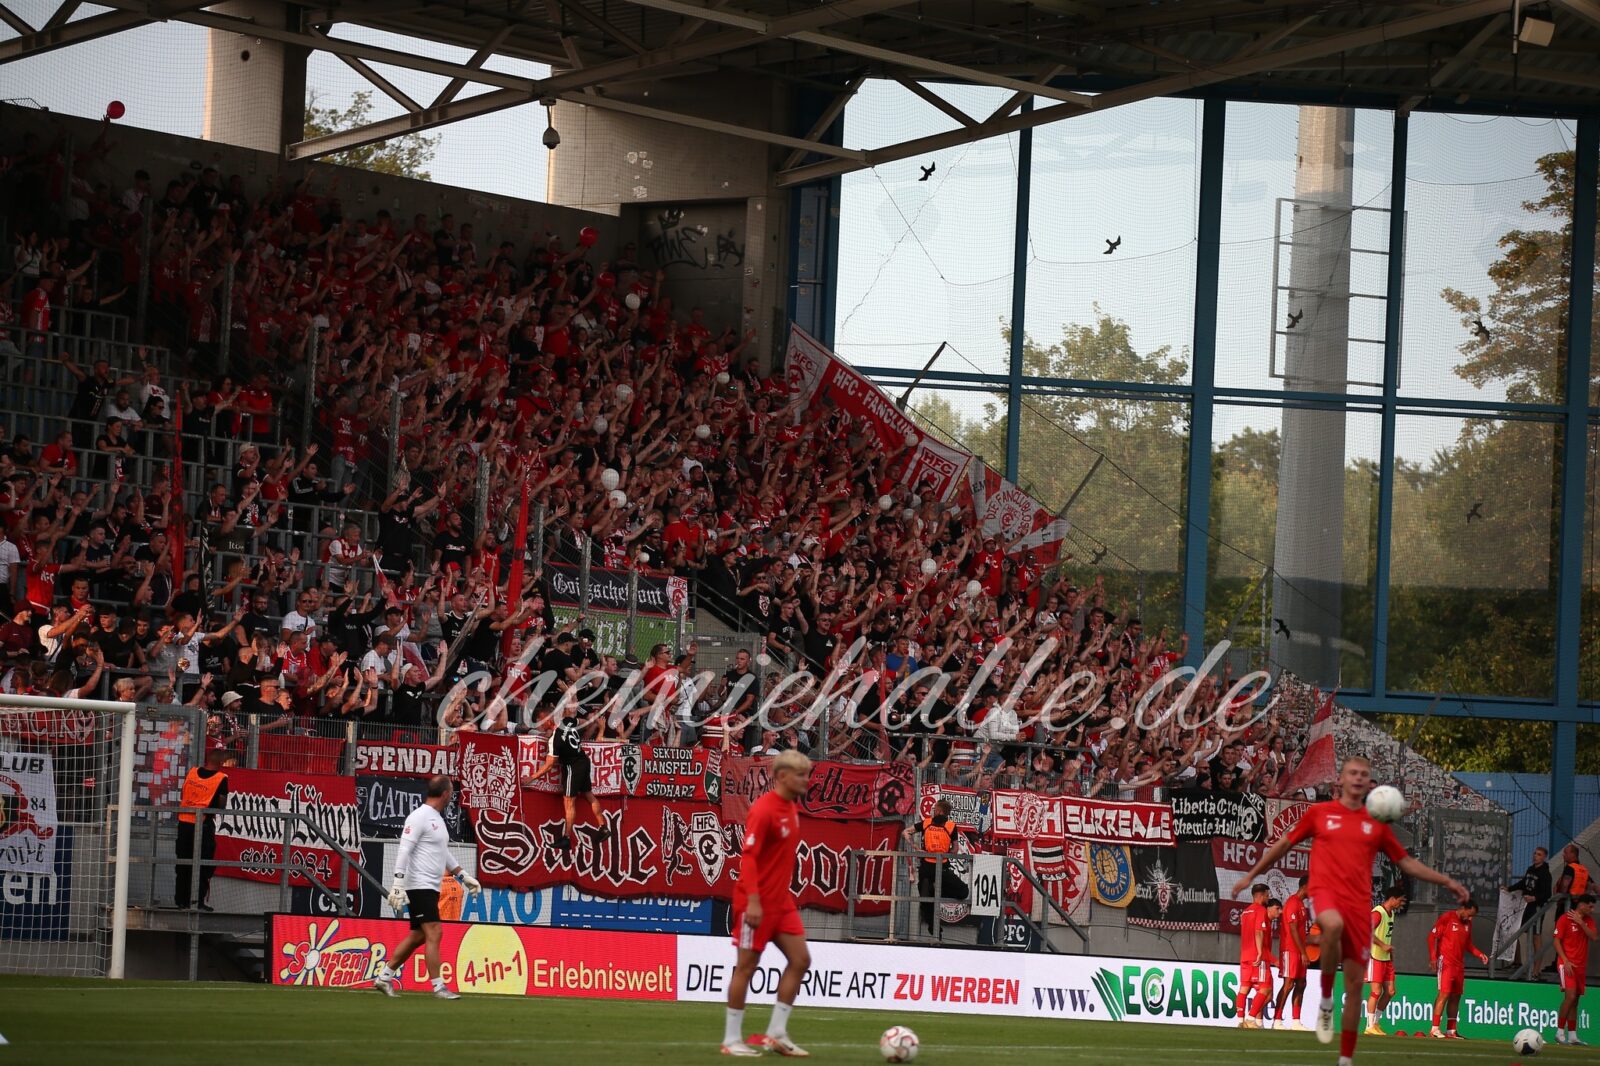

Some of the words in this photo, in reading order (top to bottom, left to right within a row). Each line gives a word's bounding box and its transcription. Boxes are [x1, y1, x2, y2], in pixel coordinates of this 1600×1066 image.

[793, 351, 814, 371] HFC
[832, 368, 857, 396] HFC
[862, 389, 914, 438] FANCLUB
[922, 449, 953, 475] HFC
[0, 755, 44, 774] LUB
[356, 744, 459, 777] STENDAL
[652, 746, 693, 760] SEKTION
[644, 759, 703, 776] MANSFELD
[646, 778, 696, 798] SÜDHARZ
[31, 796, 47, 811] 84
[696, 816, 716, 831] HFC
[1223, 842, 1257, 866] HFC
[974, 874, 999, 908] 19A
[461, 886, 543, 924] AKO
[413, 952, 453, 978] De
[463, 950, 523, 987] 4-in-1
[533, 959, 673, 993] Erlebniswelt
[686, 963, 725, 993] DIE
[731, 965, 843, 998] ODRNE
[846, 971, 891, 1000] ART
[893, 973, 925, 1001] ZU
[931, 975, 1021, 1006] WERBEN
[1464, 998, 1514, 1026] Tablet
